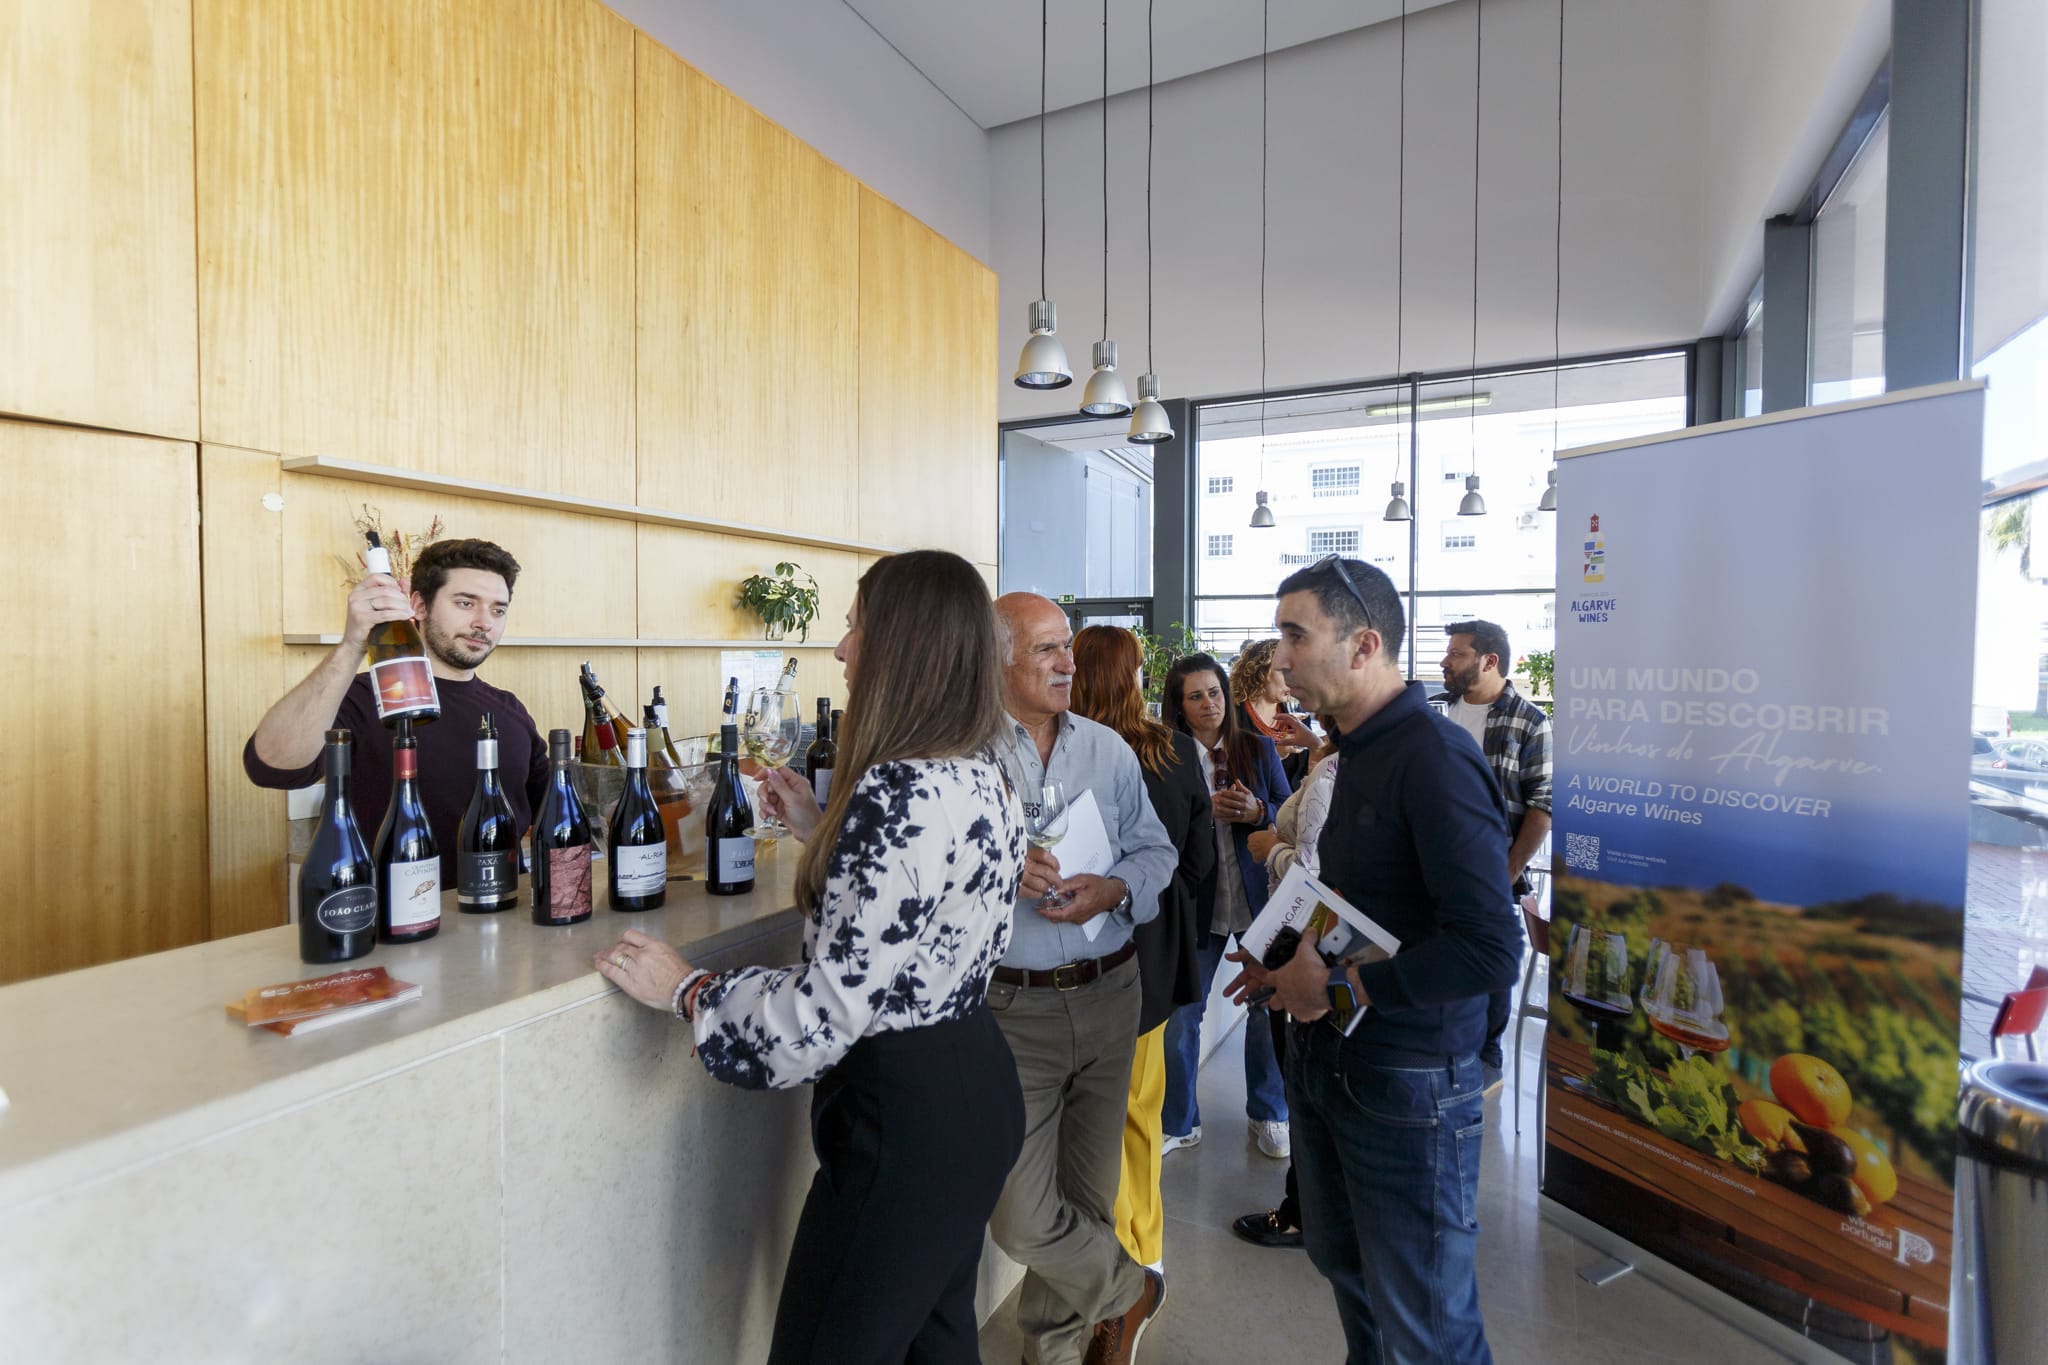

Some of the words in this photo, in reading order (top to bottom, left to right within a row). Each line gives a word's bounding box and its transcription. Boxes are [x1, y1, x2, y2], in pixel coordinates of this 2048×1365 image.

[1571, 599, 1616, 612] ALGARVE
[1579, 612, 1608, 623] WINES
[1569, 667, 1616, 691] UM
[1626, 667, 1760, 694] MUNDO
[1569, 697, 1649, 722] PARA
[1660, 700, 1891, 736] DESCOBRIR
[1568, 774, 1582, 790] A
[1587, 776, 1663, 797] WORLD
[1669, 783, 1697, 802] TO
[1702, 787, 1832, 818] DISCOVER
[1568, 794, 1638, 817] Algarve
[1644, 802, 1703, 825] Wines
[1841, 1221, 1893, 1251] portugal
